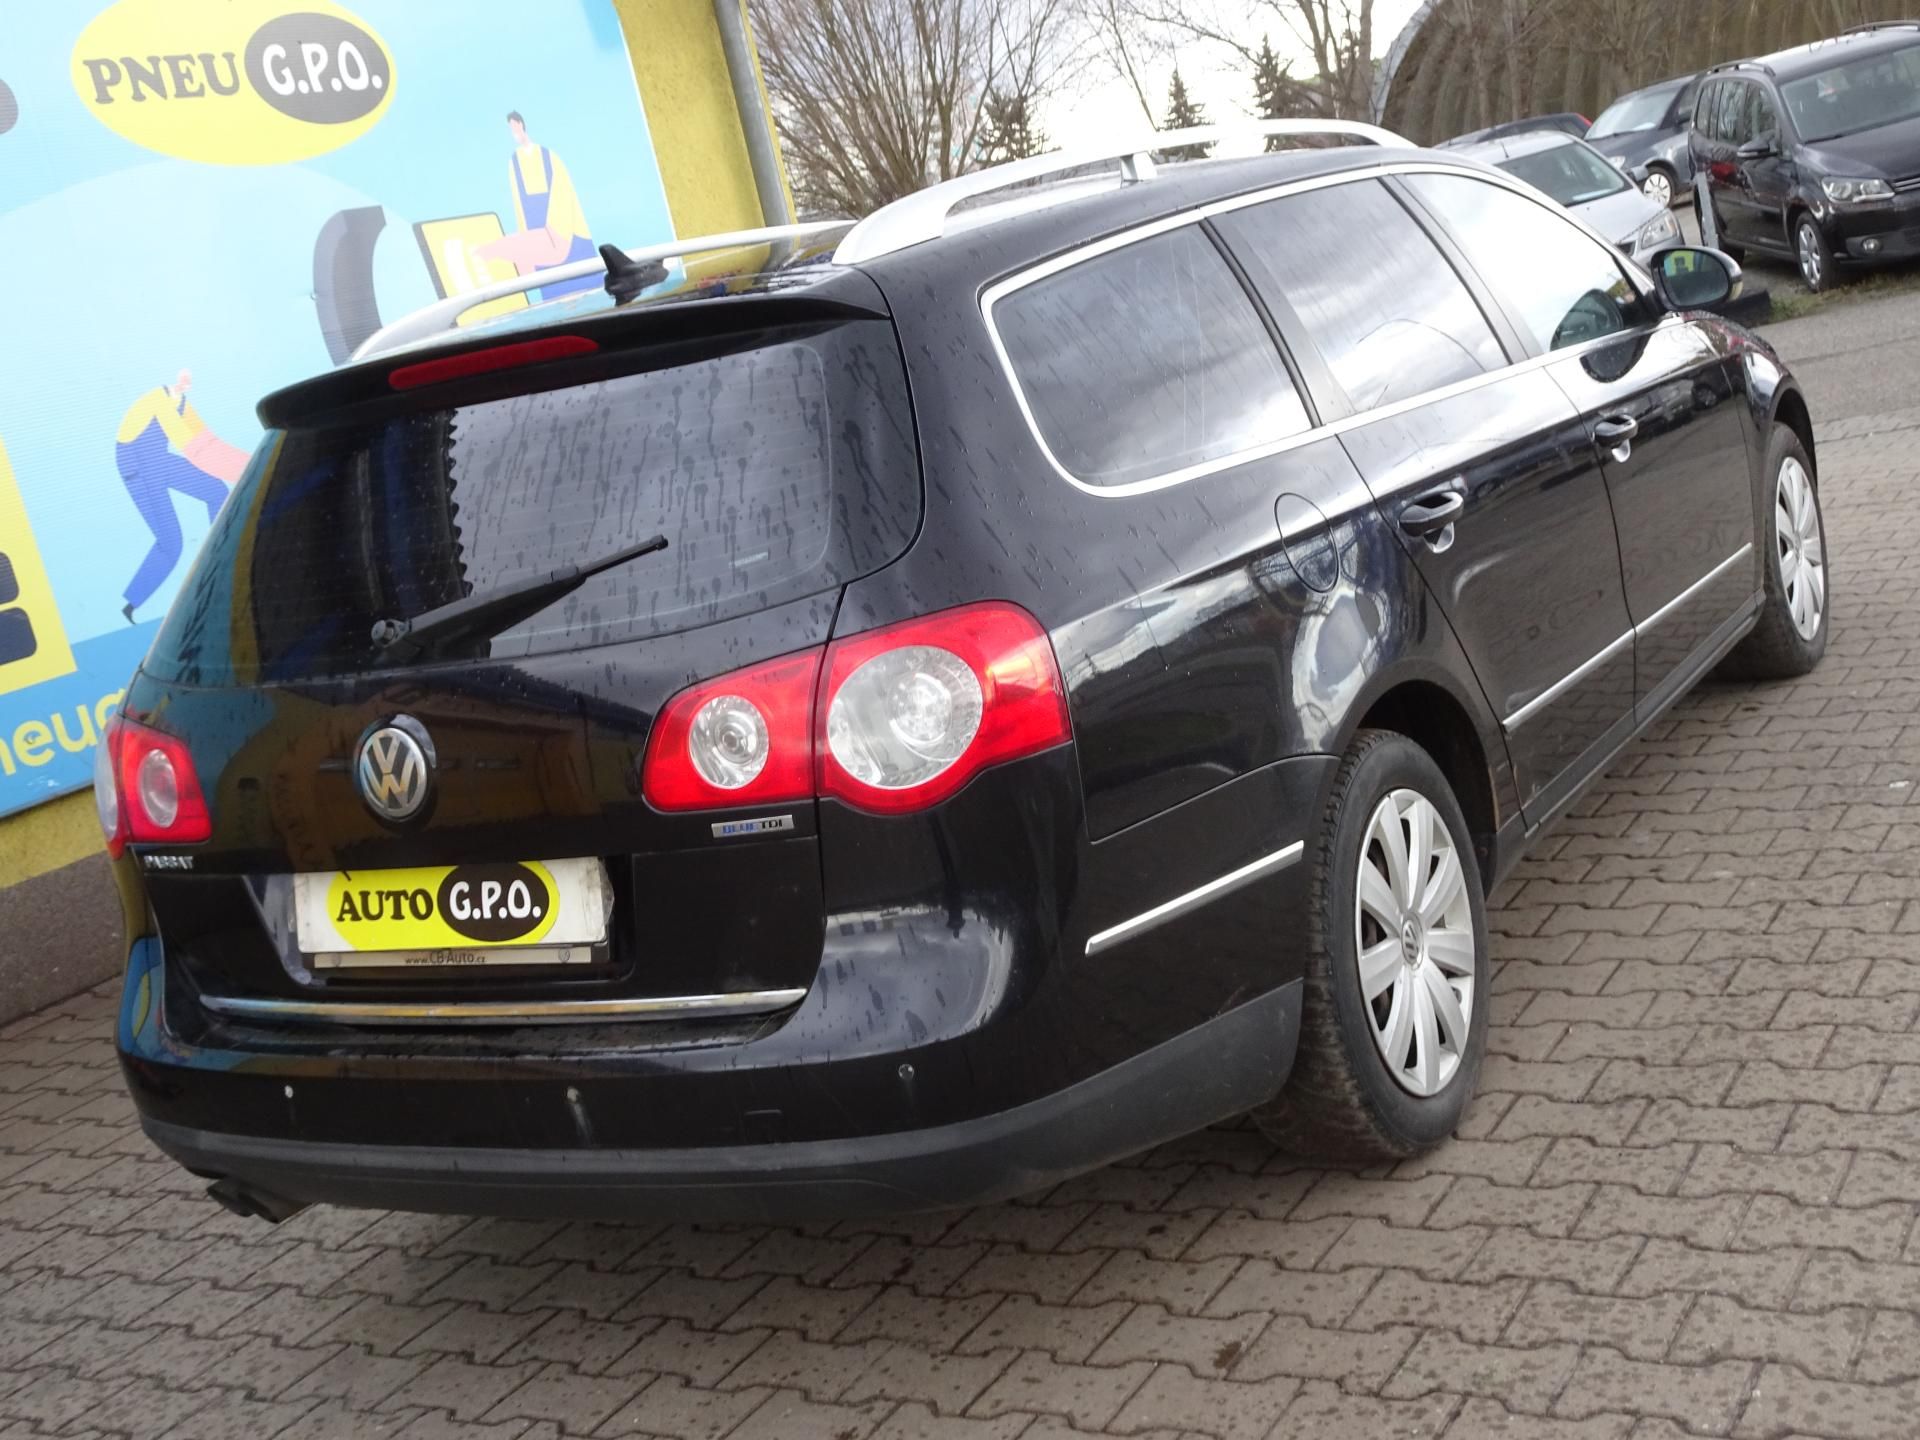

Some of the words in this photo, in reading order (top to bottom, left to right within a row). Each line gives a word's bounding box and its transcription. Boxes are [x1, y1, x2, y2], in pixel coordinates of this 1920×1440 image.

[82, 52, 240, 104] PNEU
[262, 40, 383, 96] G.P.O.
[336, 888, 434, 922] AUTO
[449, 879, 542, 921] G.P.O.
